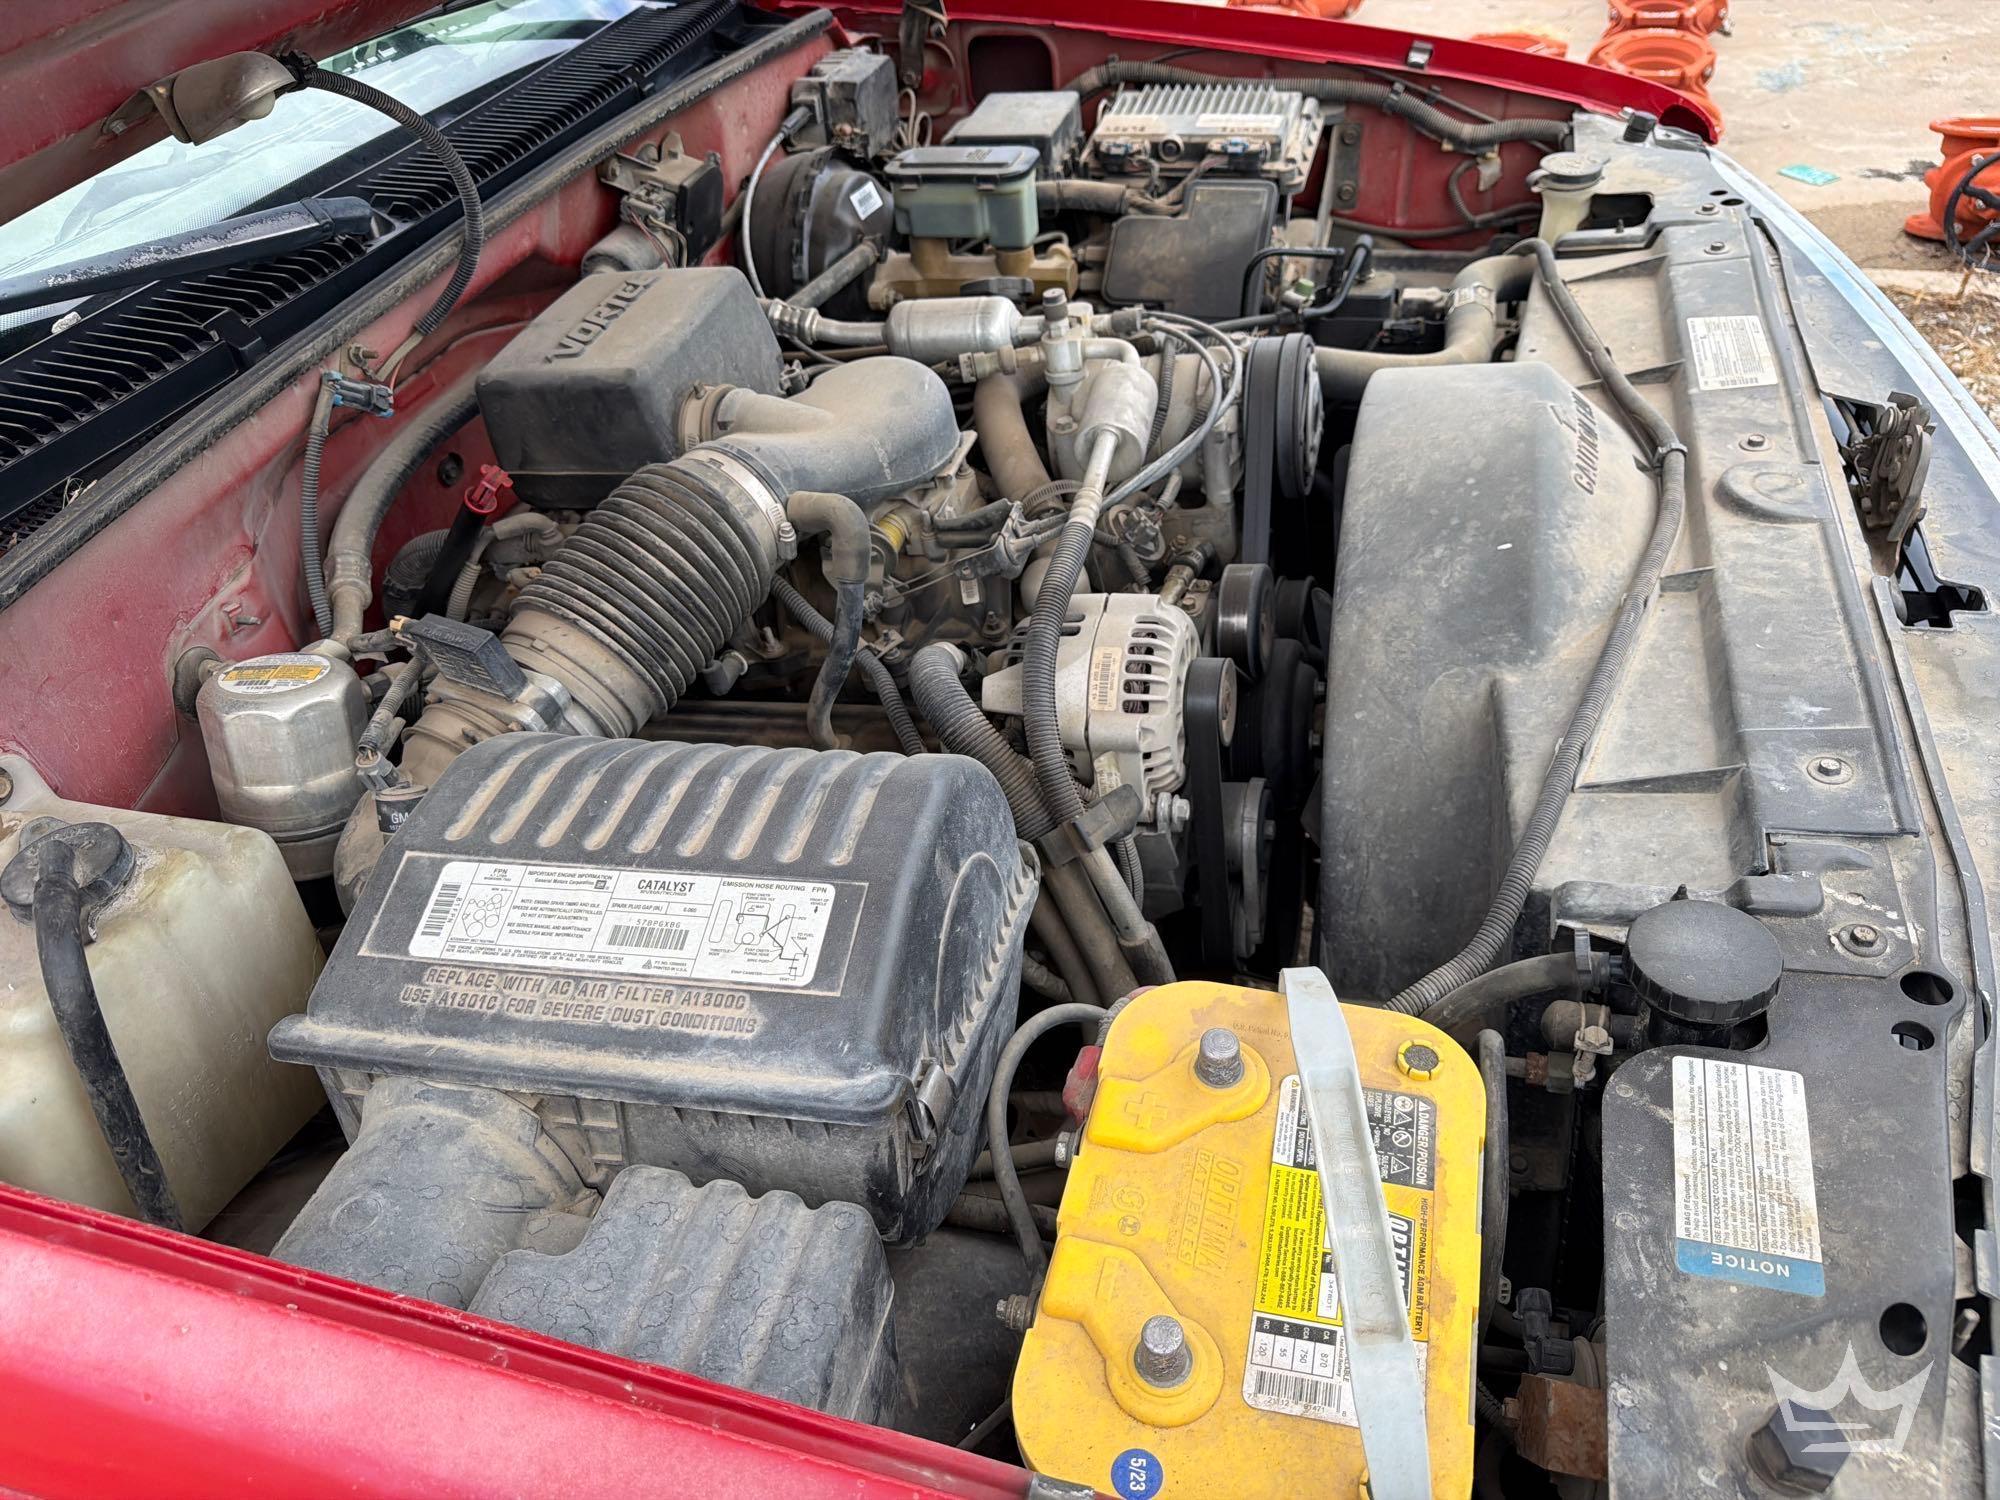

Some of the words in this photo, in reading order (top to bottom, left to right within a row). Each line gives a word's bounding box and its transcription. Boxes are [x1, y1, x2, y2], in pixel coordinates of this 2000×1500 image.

[637, 879, 696, 892] CATALYST
[426, 967, 495, 990] REPLACE
[503, 975, 541, 993] WITH
[549, 979, 573, 995] AC
[577, 982, 607, 998] AIR
[615, 985, 674, 1006] FILTER
[402, 986, 429, 1005] USE
[506, 996, 535, 1015] FOR
[541, 1001, 604, 1021] SEVERE
[610, 1007, 655, 1026] DUST
[659, 1011, 758, 1035] CONDITIONS
[1767, 1075, 1775, 1095] system
[1775, 1072, 1784, 1094] Starting
[1374, 1092, 1382, 1118] EXPLOSIVE
[1724, 1100, 1732, 1120] change
[1769, 1095, 1777, 1121] electrical
[1777, 1094, 1785, 1107] Plug
[1778, 1108, 1786, 1122] Glow
[1298, 1131, 1305, 1139] DO
[1383, 1128, 1390, 1136] NO
[1771, 1129, 1779, 1143] volts
[1780, 1130, 1789, 1151] Failure
[1416, 1112, 1429, 1186] DANGER/POISON
[1772, 1143, 1780, 1151] 12
[1380, 1155, 1389, 1179] SULFURIC
[1773, 1153, 1782, 1177] nominal
[1683, 1173, 1691, 1203] Equipped)
[1700, 1170, 1708, 1204] procedures
[1711, 1165, 1719, 1195] COOLANT
[1745, 1174, 1753, 1190] more
[1757, 1165, 1766, 1195] Equipped)
[1775, 1178, 1783, 1191] than
[1181, 1151, 1211, 1263] BATTERIES
[1729, 1189, 1737, 1212] shorten
[1776, 1192, 1784, 1209] more
[1785, 1195, 1793, 1203] or
[1199, 1159, 1240, 1272] OPTIMA
[1684, 1211, 1692, 1226] BAG
[1701, 1205, 1709, 1228] service
[1747, 1201, 1755, 1223] Manual
[1760, 1203, 1768, 1228] ENGINE
[1777, 1211, 1785, 1228] apply
[1786, 1202, 1795, 1231] charging
[1283, 1226, 1291, 1249] Customer
[1313, 1210, 1322, 1246] Replacement
[1416, 1198, 1428, 1274] HIGH-PERFORMANCE
[1702, 1228, 1710, 1241] and
[1731, 1224, 1739, 1246] coolant
[1748, 1224, 1757, 1249] Owner's
[1761, 1228, 1770, 1252] DIESEL
[1779, 1240, 1787, 1251] Do
[1788, 1232, 1797, 1253] during
[1274, 1231, 1284, 1278] optimabatteries.com
[1711, 1252, 1790, 1278] NOTICE
[1310, 1260, 1318, 1276] Proof
[1416, 1275, 1425, 1295] AGM
[1307, 1284, 1316, 1313] Purchase.
[1263, 1320, 1270, 1330] RC
[1414, 1295, 1424, 1333] BATTERY
[1283, 1323, 1290, 1333] AH
[1323, 1330, 1330, 1341] CA
[1258, 1342, 1267, 1357] 120
[1279, 1347, 1287, 1358] 55
[1299, 1349, 1308, 1364] 750
[1319, 1353, 1328, 1368] 870
[1129, 1457, 1147, 1491] 5/23
